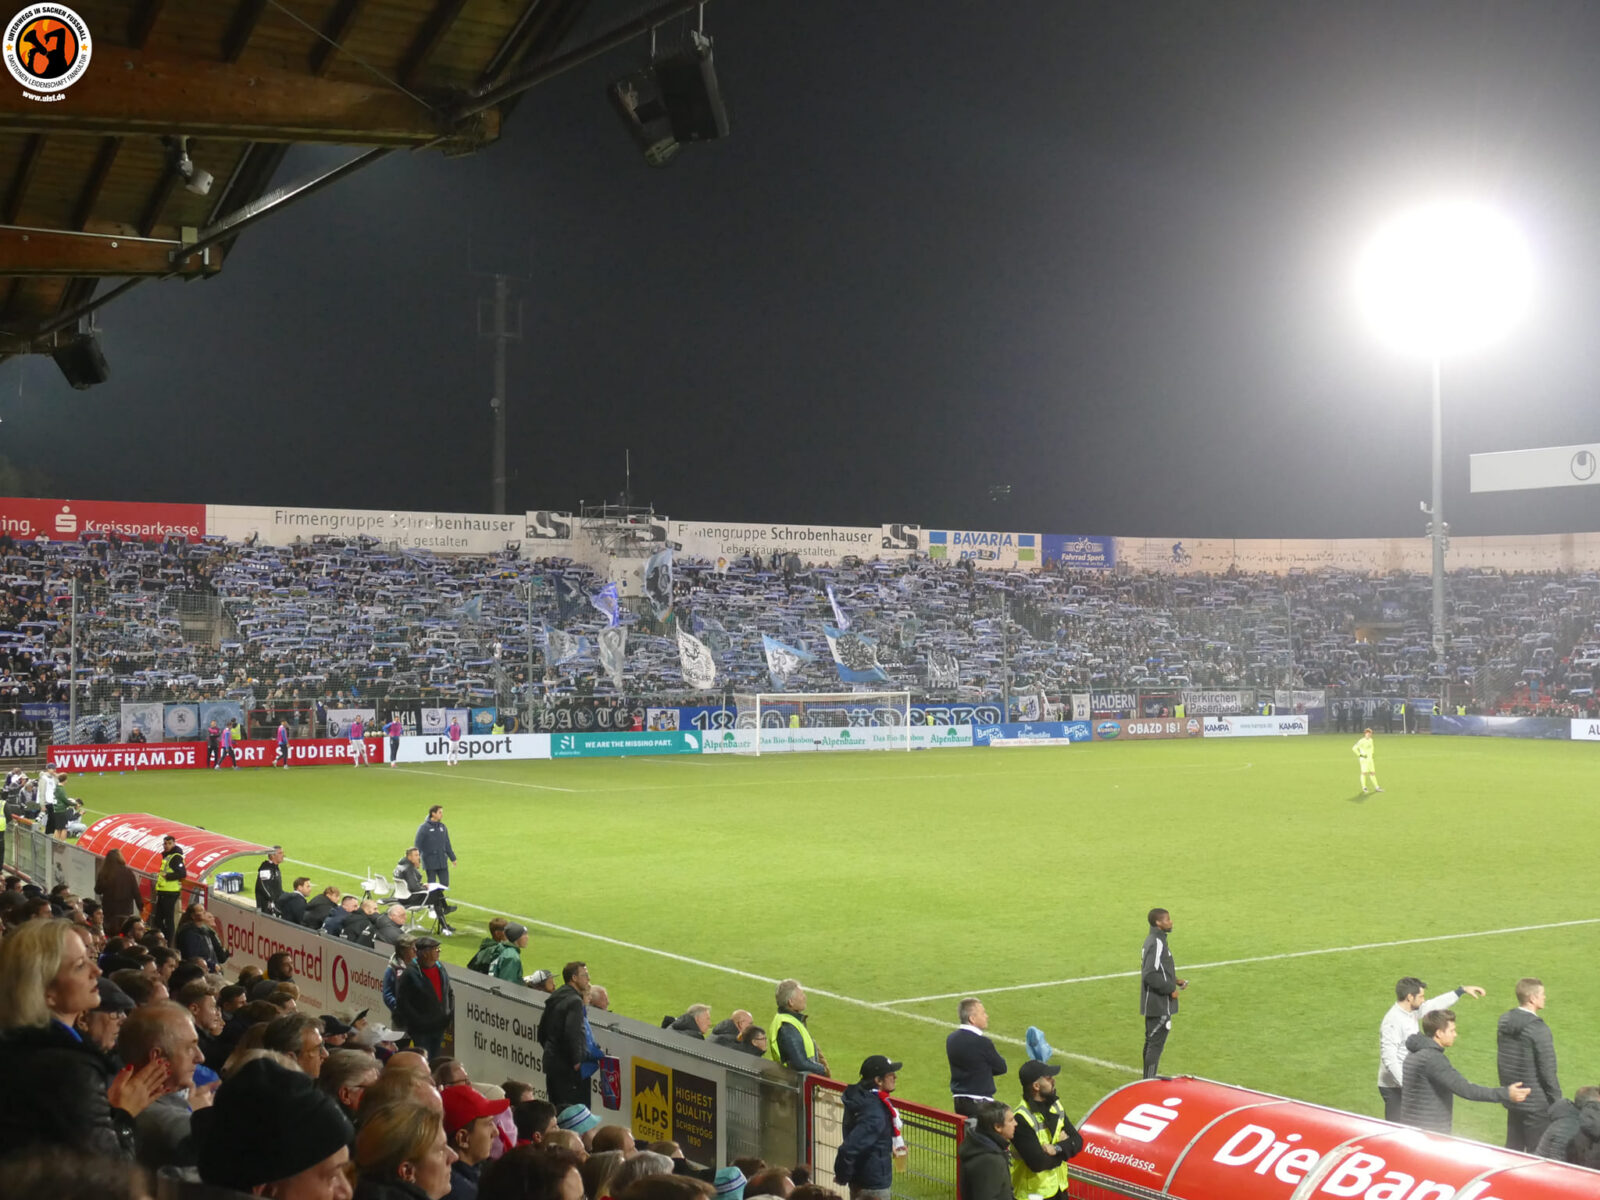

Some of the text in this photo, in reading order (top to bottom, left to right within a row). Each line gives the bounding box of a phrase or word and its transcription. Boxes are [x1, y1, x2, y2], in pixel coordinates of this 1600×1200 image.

[85, 520, 199, 537] Kreissparkasse
[275, 510, 385, 530] Firmengruppe
[414, 535, 469, 548] gestalten
[678, 524, 873, 543] Fmengruppe Schrobenhauser
[953, 532, 1013, 547] BAVARIA
[960, 547, 1001, 560] petol
[1061, 552, 1087, 561] Fahrrad
[1182, 691, 1237, 704] Vierkirchen
[1190, 702, 1242, 714] Pasenbach
[690, 709, 787, 731] 1860
[1127, 723, 1163, 735] OBAZD
[1166, 722, 1181, 734] IS!
[1204, 724, 1230, 732] KAMPA
[1278, 722, 1304, 730] KAMPA
[821, 735, 867, 748] Alpenbauer
[886, 734, 925, 742] Bio-Bobon
[930, 733, 972, 746] Alpenbauer
[1075, 728, 1090, 739] Park
[0, 737, 38, 757] ACH
[275, 742, 378, 758] STUDIERE?
[425, 736, 512, 758] uhsport
[585, 741, 596, 749] WE
[654, 739, 673, 747] PART.
[53, 750, 196, 769] WWW.FHAM.DE
[227, 921, 255, 958] good
[350, 967, 385, 993] vodafone
[466, 1001, 510, 1032] Höchster
[474, 1030, 488, 1050] für
[490, 1036, 508, 1059] den
[675, 1087, 713, 1109] HIGHEST
[635, 1100, 668, 1130] ALPS
[675, 1102, 713, 1124] QUALITY
[638, 1124, 665, 1141] COFFEE
[1084, 1142, 1156, 1173] Kreissparkasse
[1213, 1123, 1320, 1186] Die
